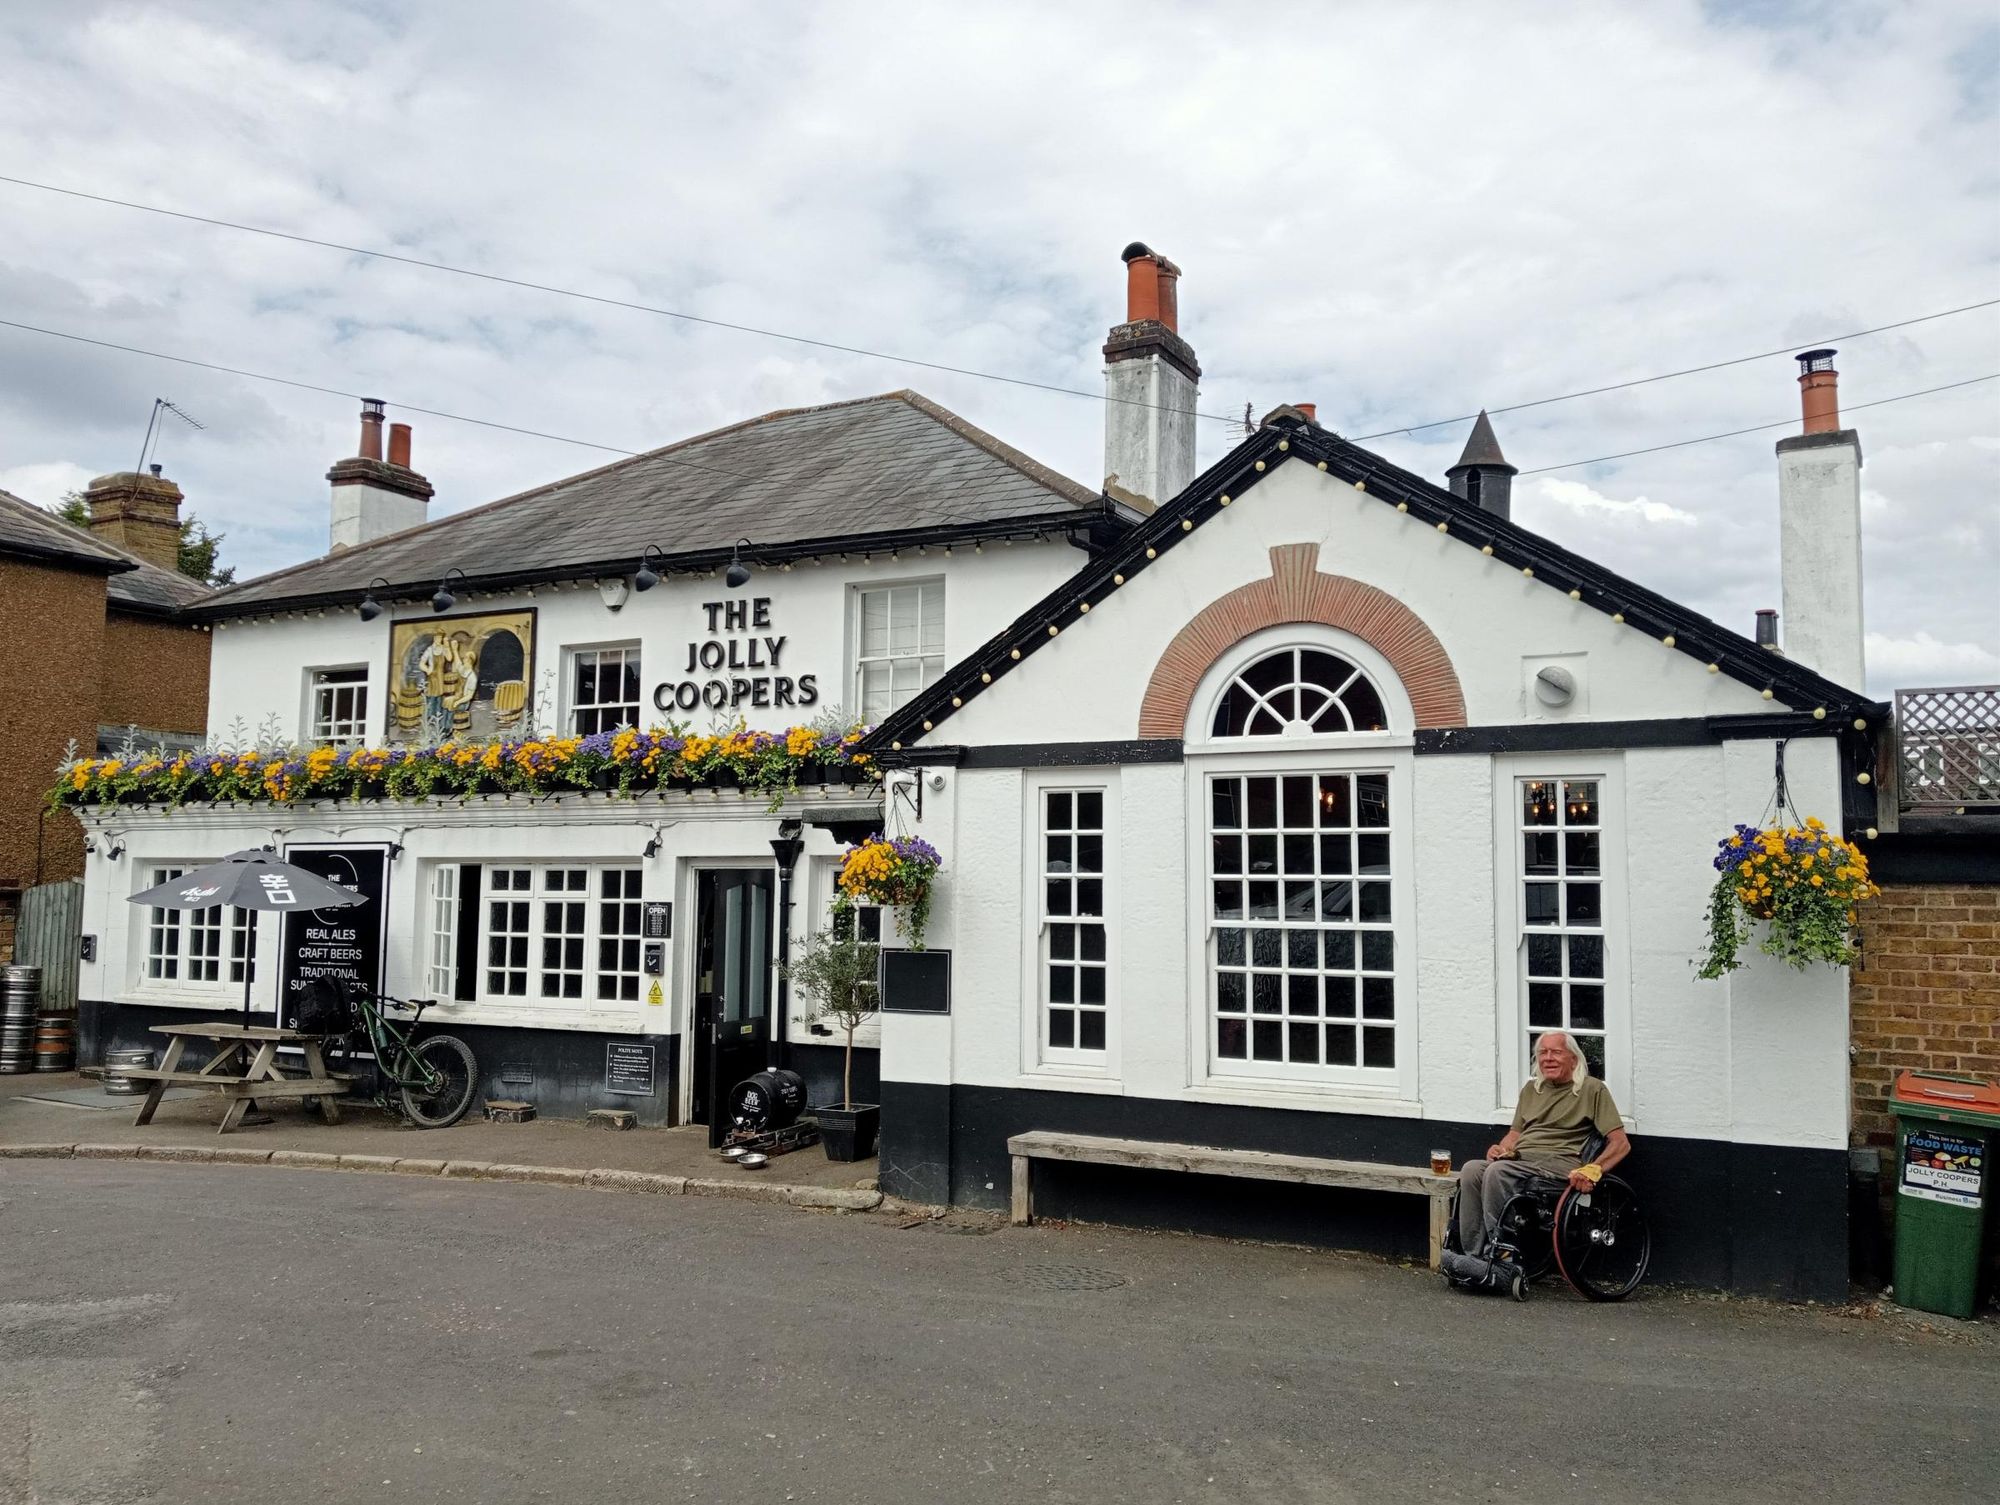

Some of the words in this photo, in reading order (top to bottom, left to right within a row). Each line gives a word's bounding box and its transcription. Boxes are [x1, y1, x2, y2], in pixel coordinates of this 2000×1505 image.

[702, 597, 771, 632] THE
[685, 635, 787, 673] JOLLY
[653, 674, 818, 711] COOPERS
[327, 874, 340, 883] THE
[306, 928, 329, 940] REAL
[331, 929, 356, 940] ALES
[298, 947, 328, 959] CRAFT
[330, 948, 362, 960] BEERS
[299, 966, 359, 979] TRADITIONAL
[1909, 1137, 1941, 1149] FOOD
[1942, 1143, 1982, 1155] WASTE
[1908, 1167, 1935, 1176] JOLLY
[1936, 1172, 1979, 1184] COOPERS
